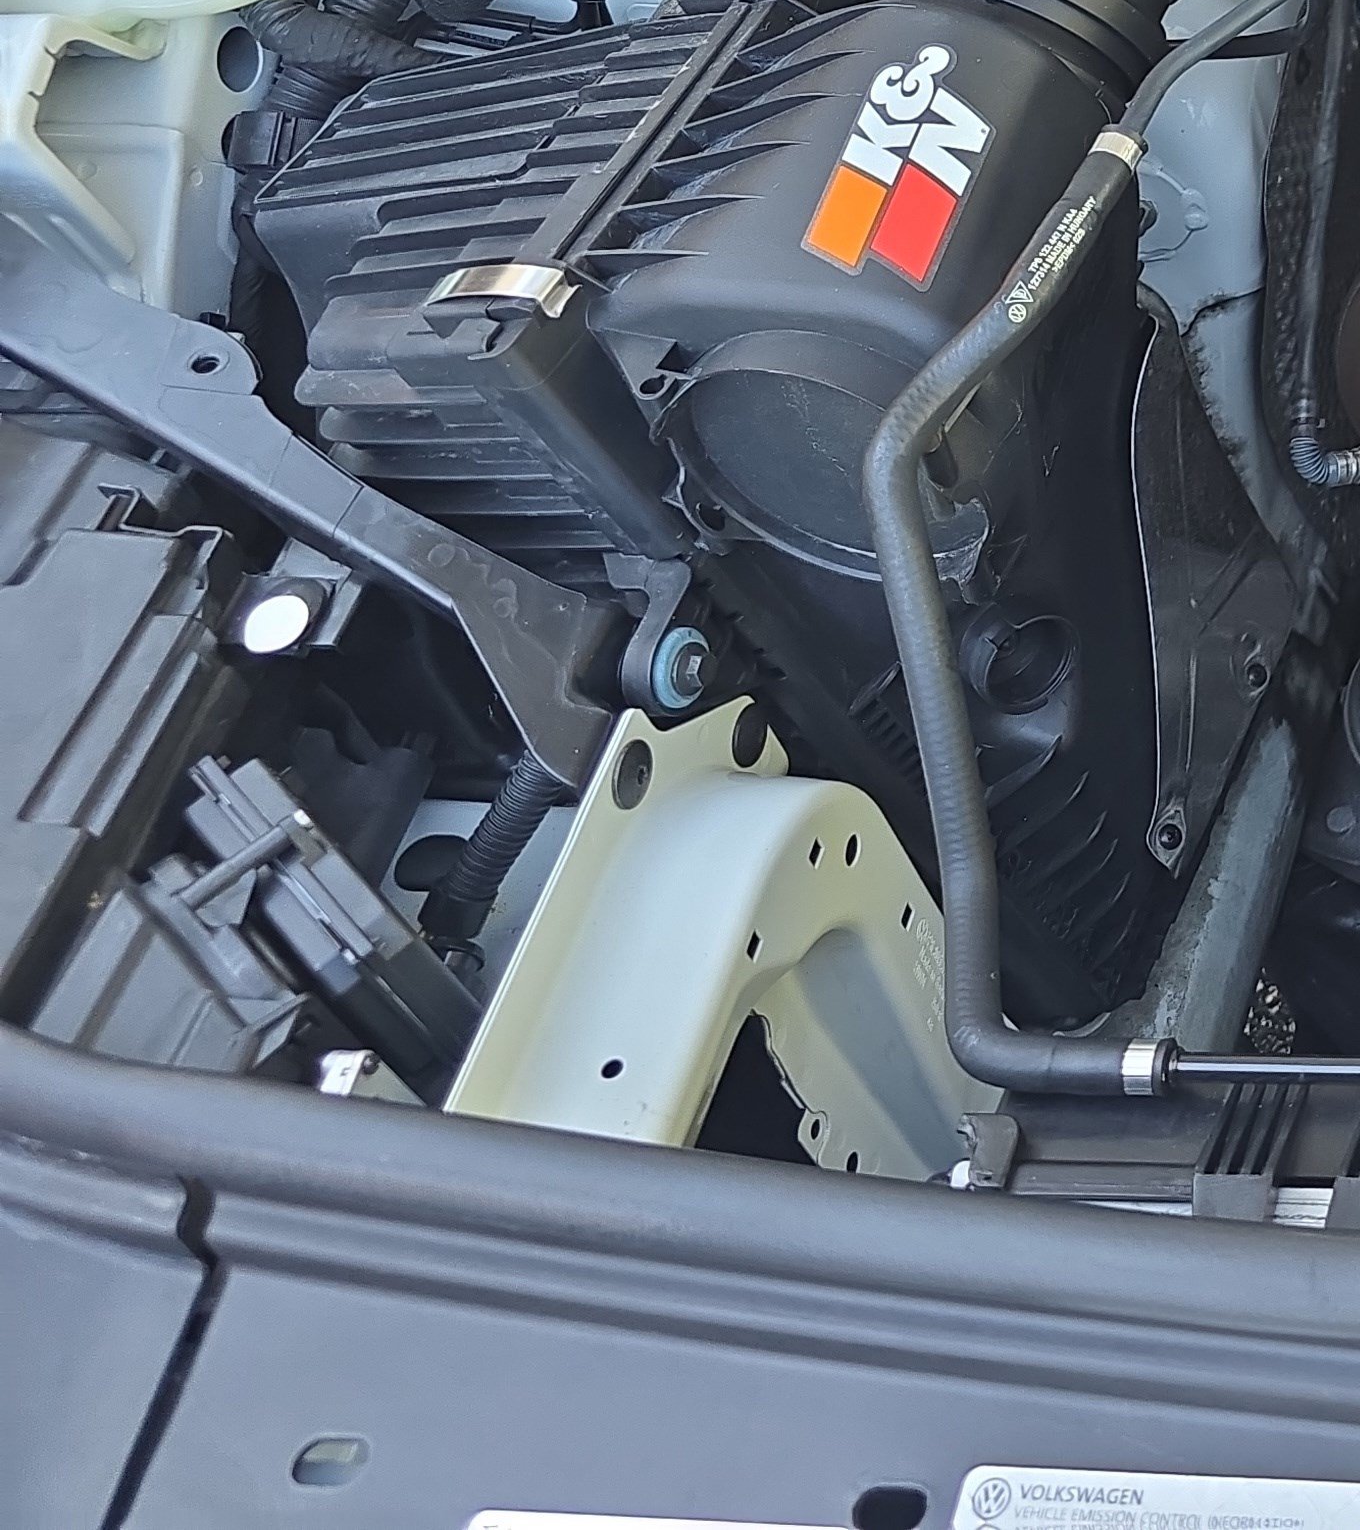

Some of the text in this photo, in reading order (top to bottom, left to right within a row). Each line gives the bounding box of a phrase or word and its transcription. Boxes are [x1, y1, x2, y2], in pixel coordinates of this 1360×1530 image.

[842, 45, 994, 197] K&N
[1045, 240, 1067, 265] MADE
[1067, 195, 1097, 232] HUNGARY
[1012, 1506, 1068, 1521] VEHICLE
[1070, 1508, 1136, 1524] EMISSION
[1018, 1483, 1145, 1506] VOLKSWAGEN
